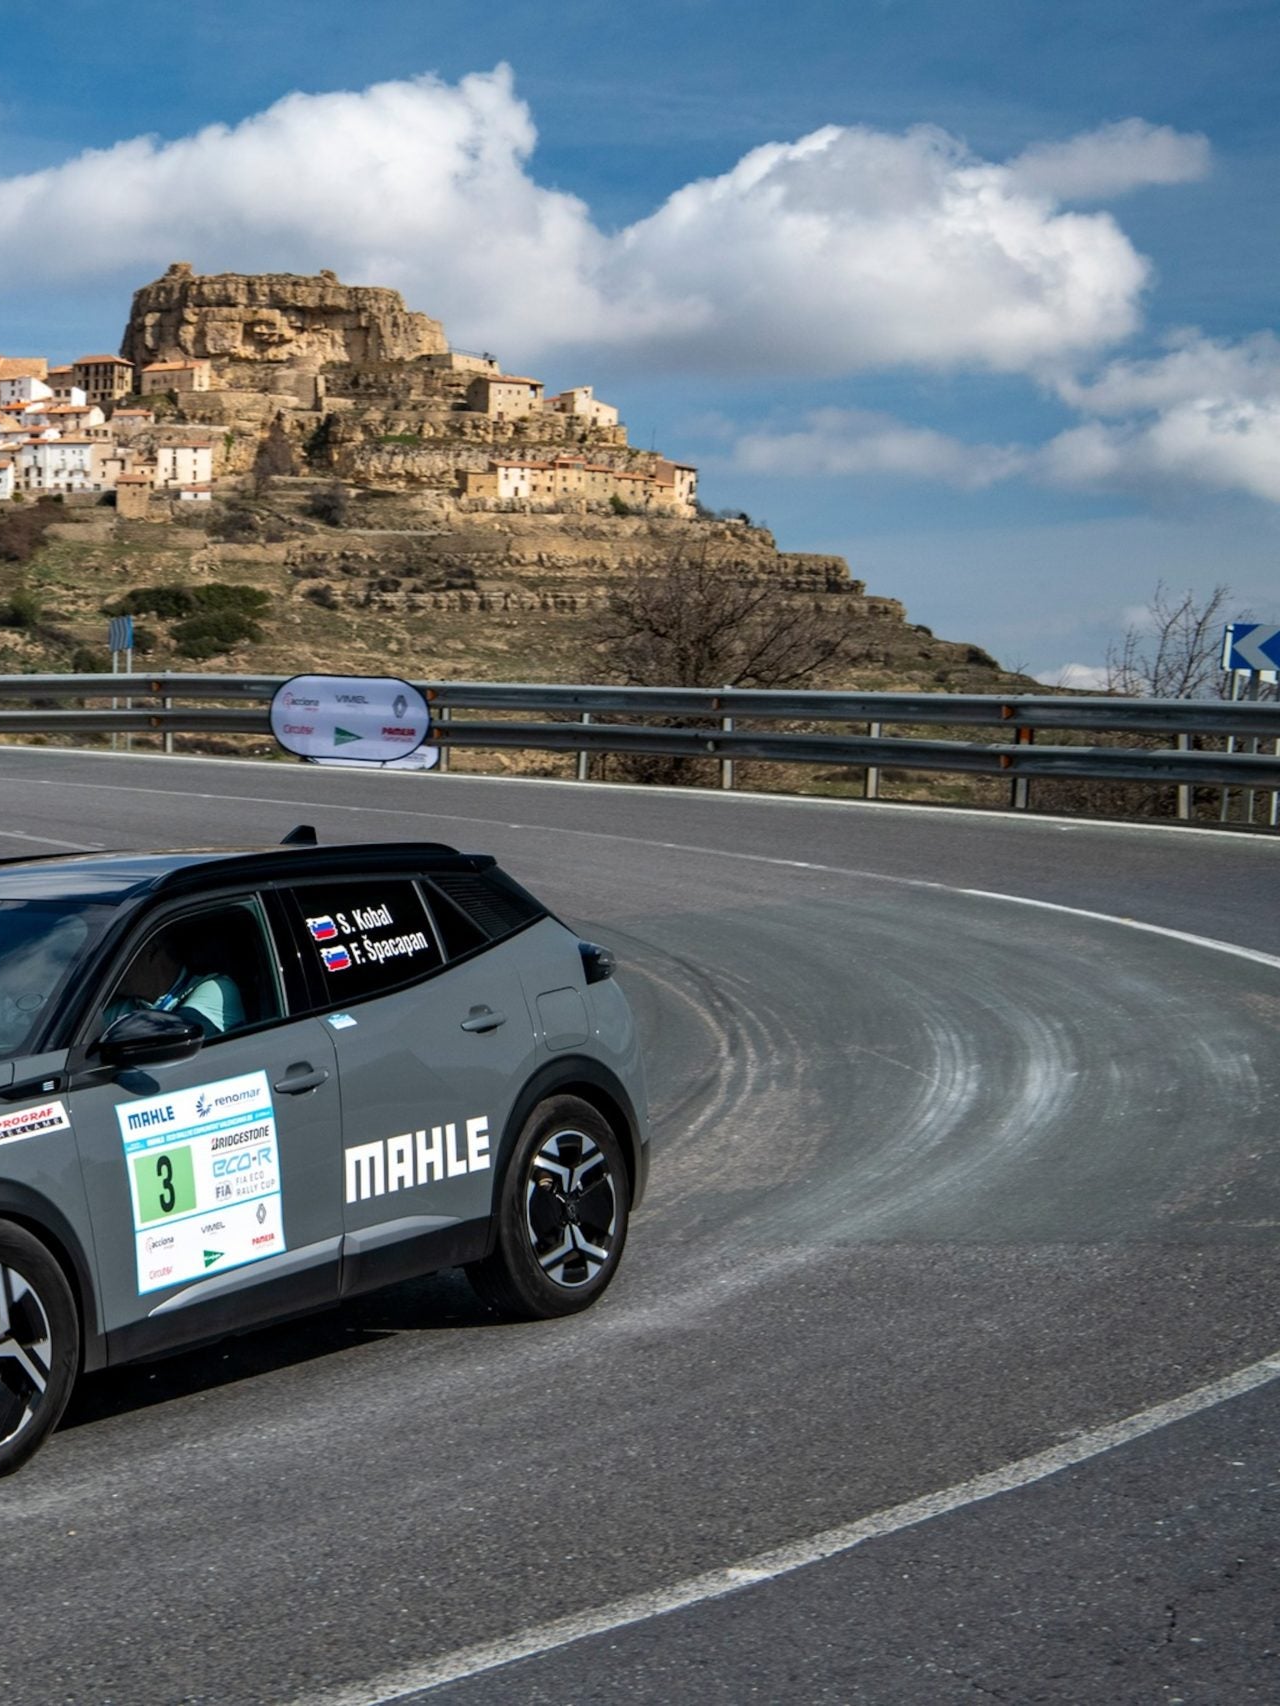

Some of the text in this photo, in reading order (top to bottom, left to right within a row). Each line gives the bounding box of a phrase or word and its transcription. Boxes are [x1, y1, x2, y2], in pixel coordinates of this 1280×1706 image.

[336, 903, 393, 934] S. Kobal
[349, 934, 428, 964] F. Špacapan
[215, 1087, 261, 1106] renomar
[128, 1105, 175, 1130] MAHLE
[211, 1125, 270, 1150] BRIDGESTONE
[345, 1115, 490, 1203] MAHLE
[156, 1155, 176, 1213] 3
